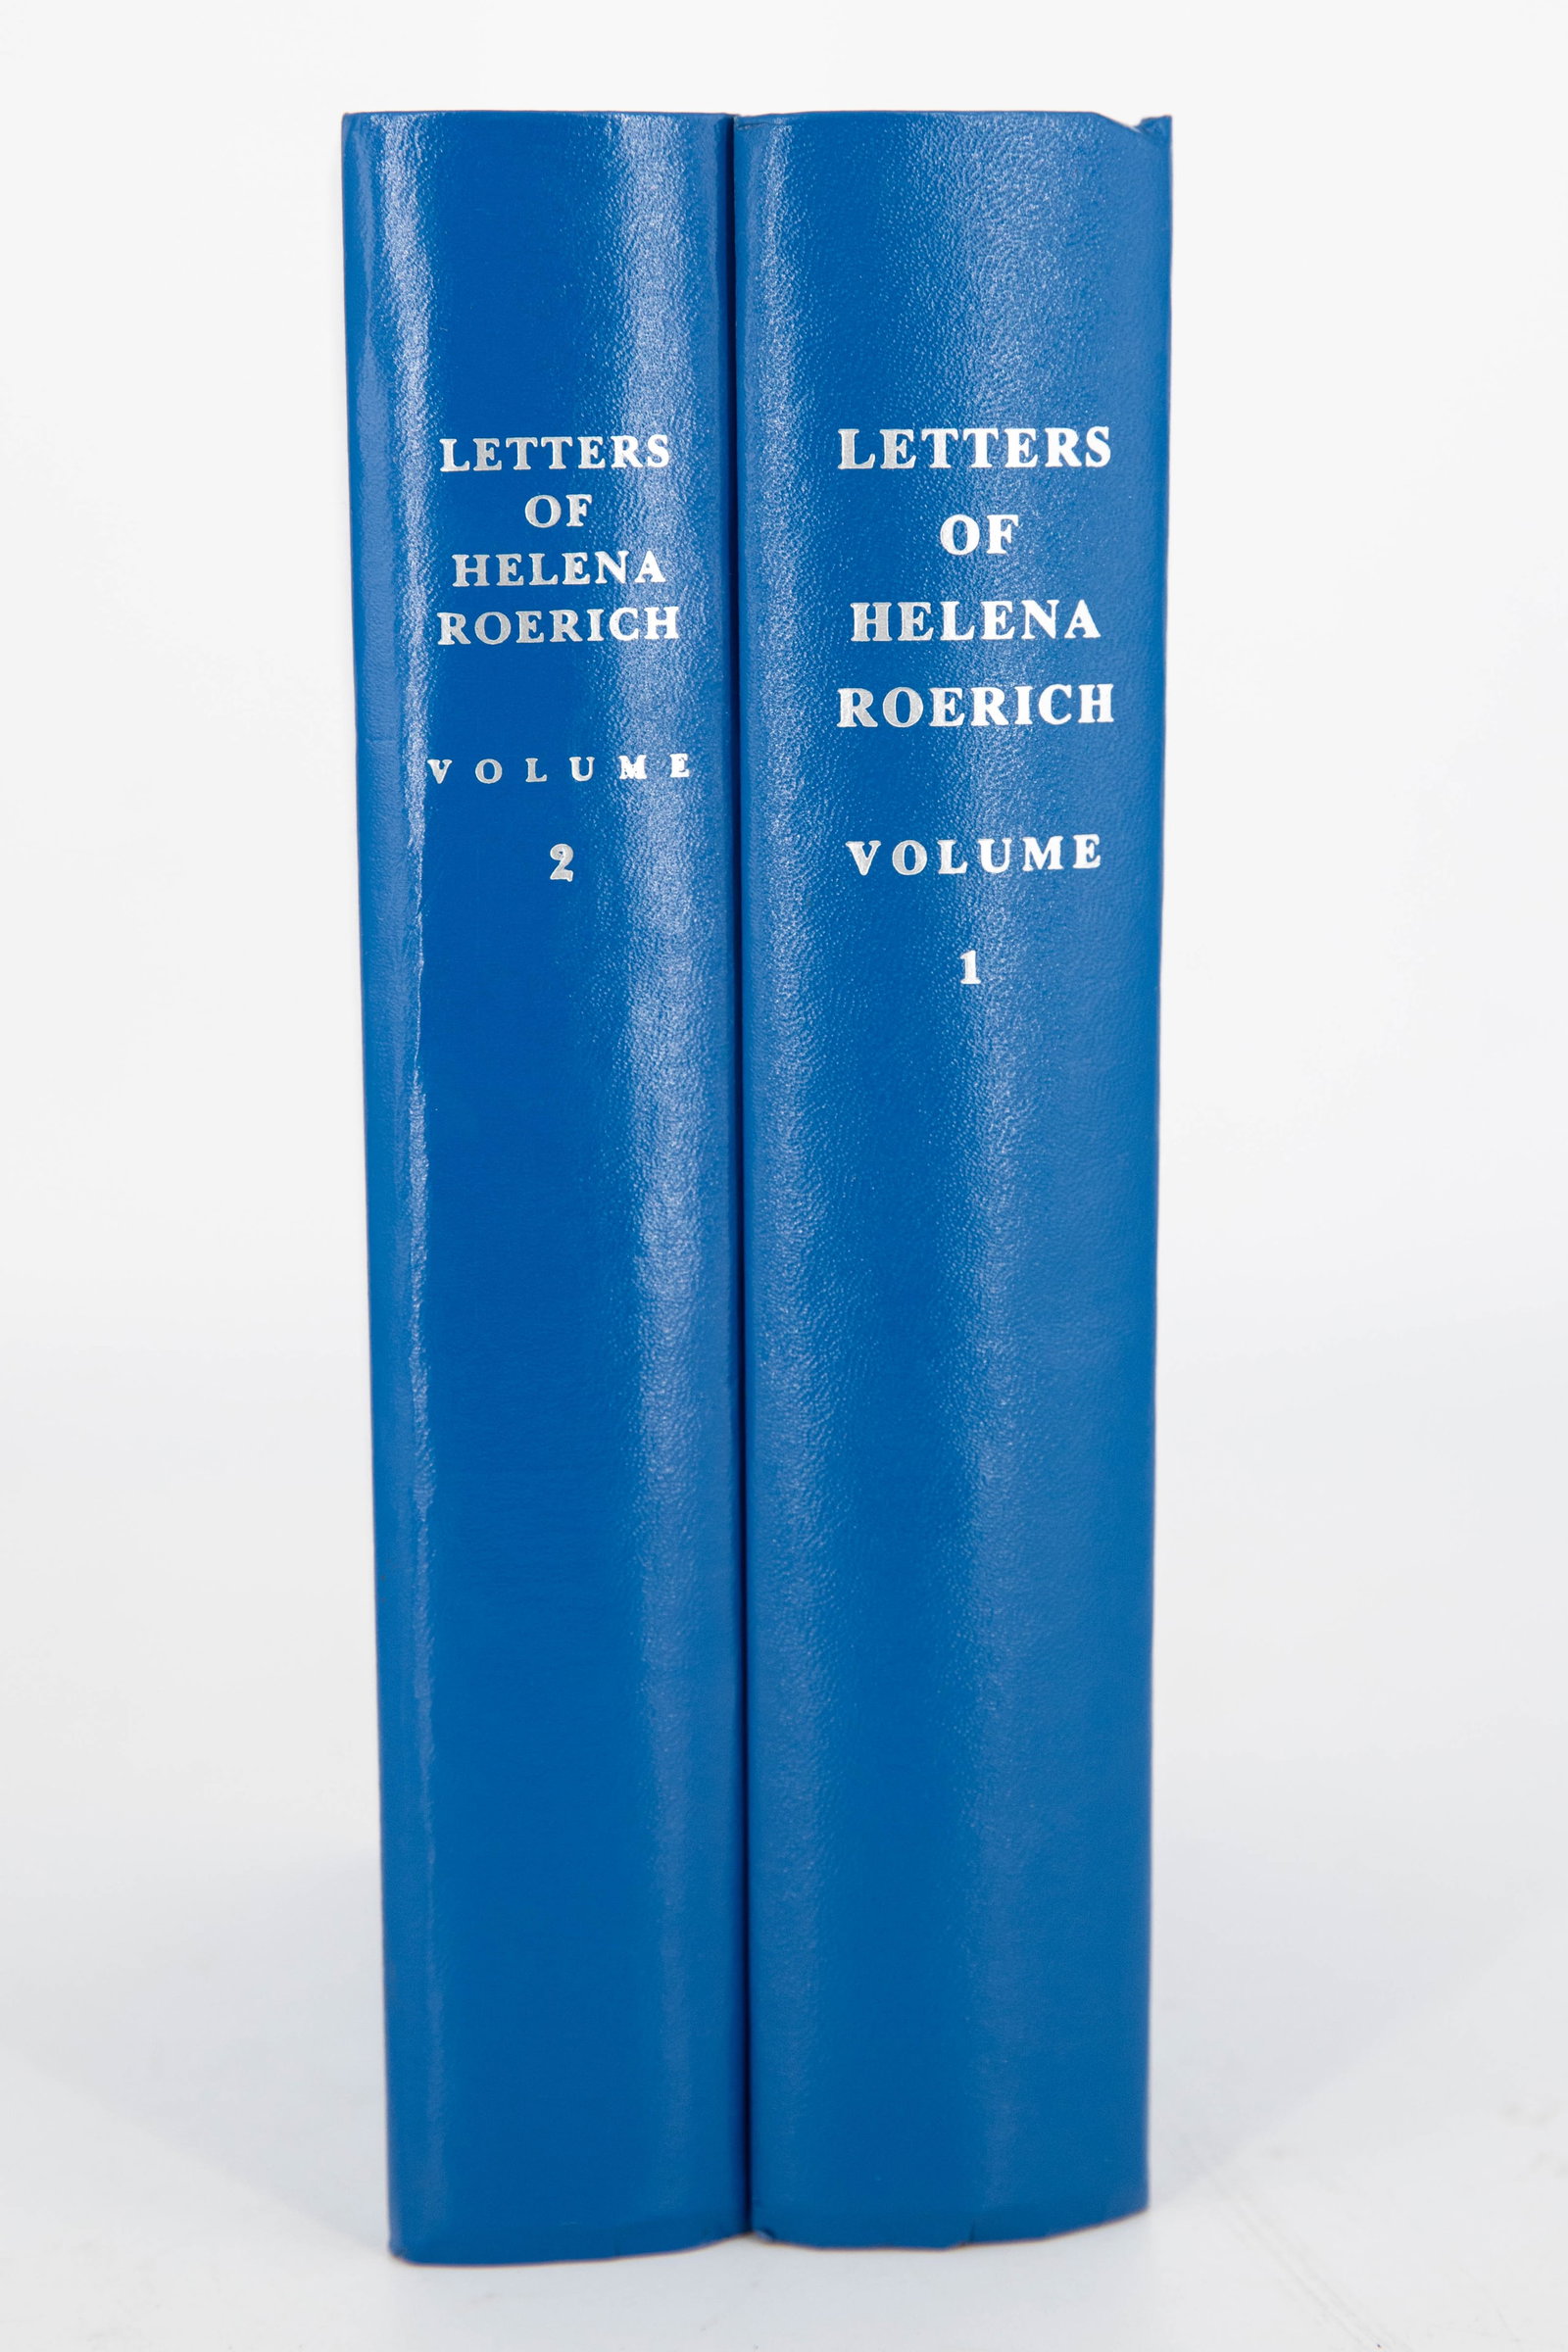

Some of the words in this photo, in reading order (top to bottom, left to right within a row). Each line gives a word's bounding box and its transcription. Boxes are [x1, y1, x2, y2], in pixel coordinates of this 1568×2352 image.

[440, 432, 671, 473] LETTERS
[838, 426, 1111, 470] LETTERS
[524, 494, 593, 529] OF
[940, 514, 1019, 556] OF
[452, 547, 667, 588] HELENA
[437, 606, 680, 647] ROERICH
[850, 599, 1102, 642] HELENA
[837, 683, 1114, 728] ROERICH
[427, 753, 692, 785] VOLUME
[549, 843, 575, 882] 2
[846, 833, 1102, 876] VOLUME
[958, 949, 982, 986] 1
